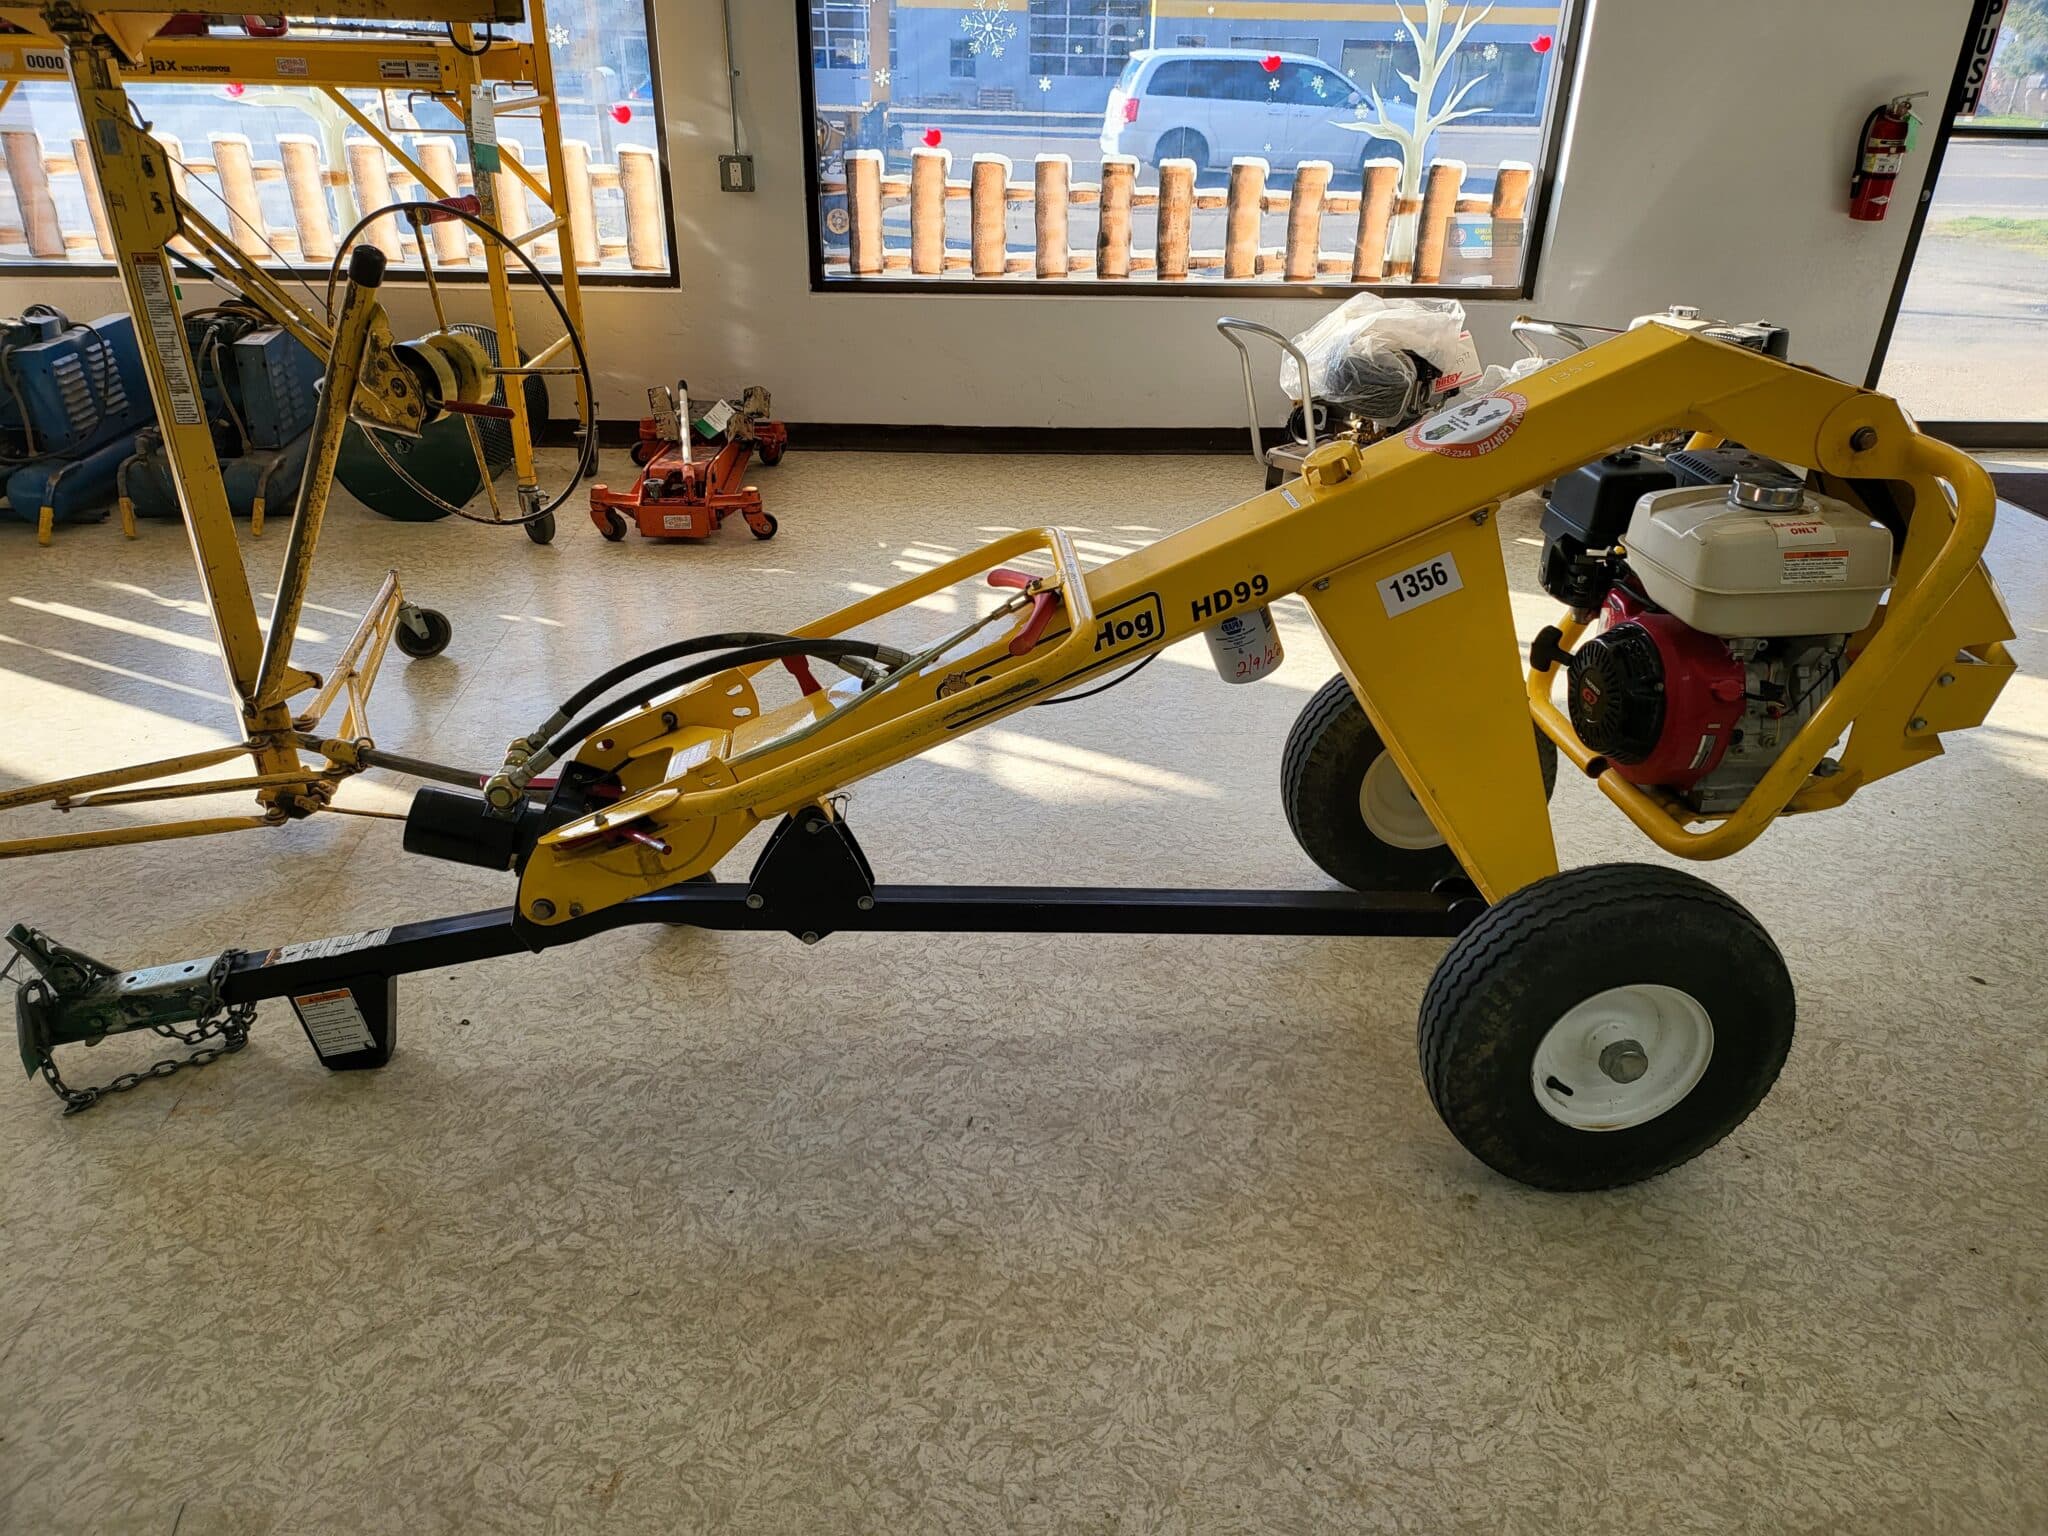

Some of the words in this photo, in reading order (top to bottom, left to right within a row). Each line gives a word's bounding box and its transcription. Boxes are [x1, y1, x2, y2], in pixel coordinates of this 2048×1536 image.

[26, 54, 65, 69] 0000
[1960, 0, 2004, 113] PUSH
[1477, 424, 1514, 455] CENTER
[1790, 527, 1818, 535] ONLY
[1191, 574, 1269, 622] HD99
[1389, 561, 1449, 603] 1356
[1094, 609, 1154, 652] Hog
